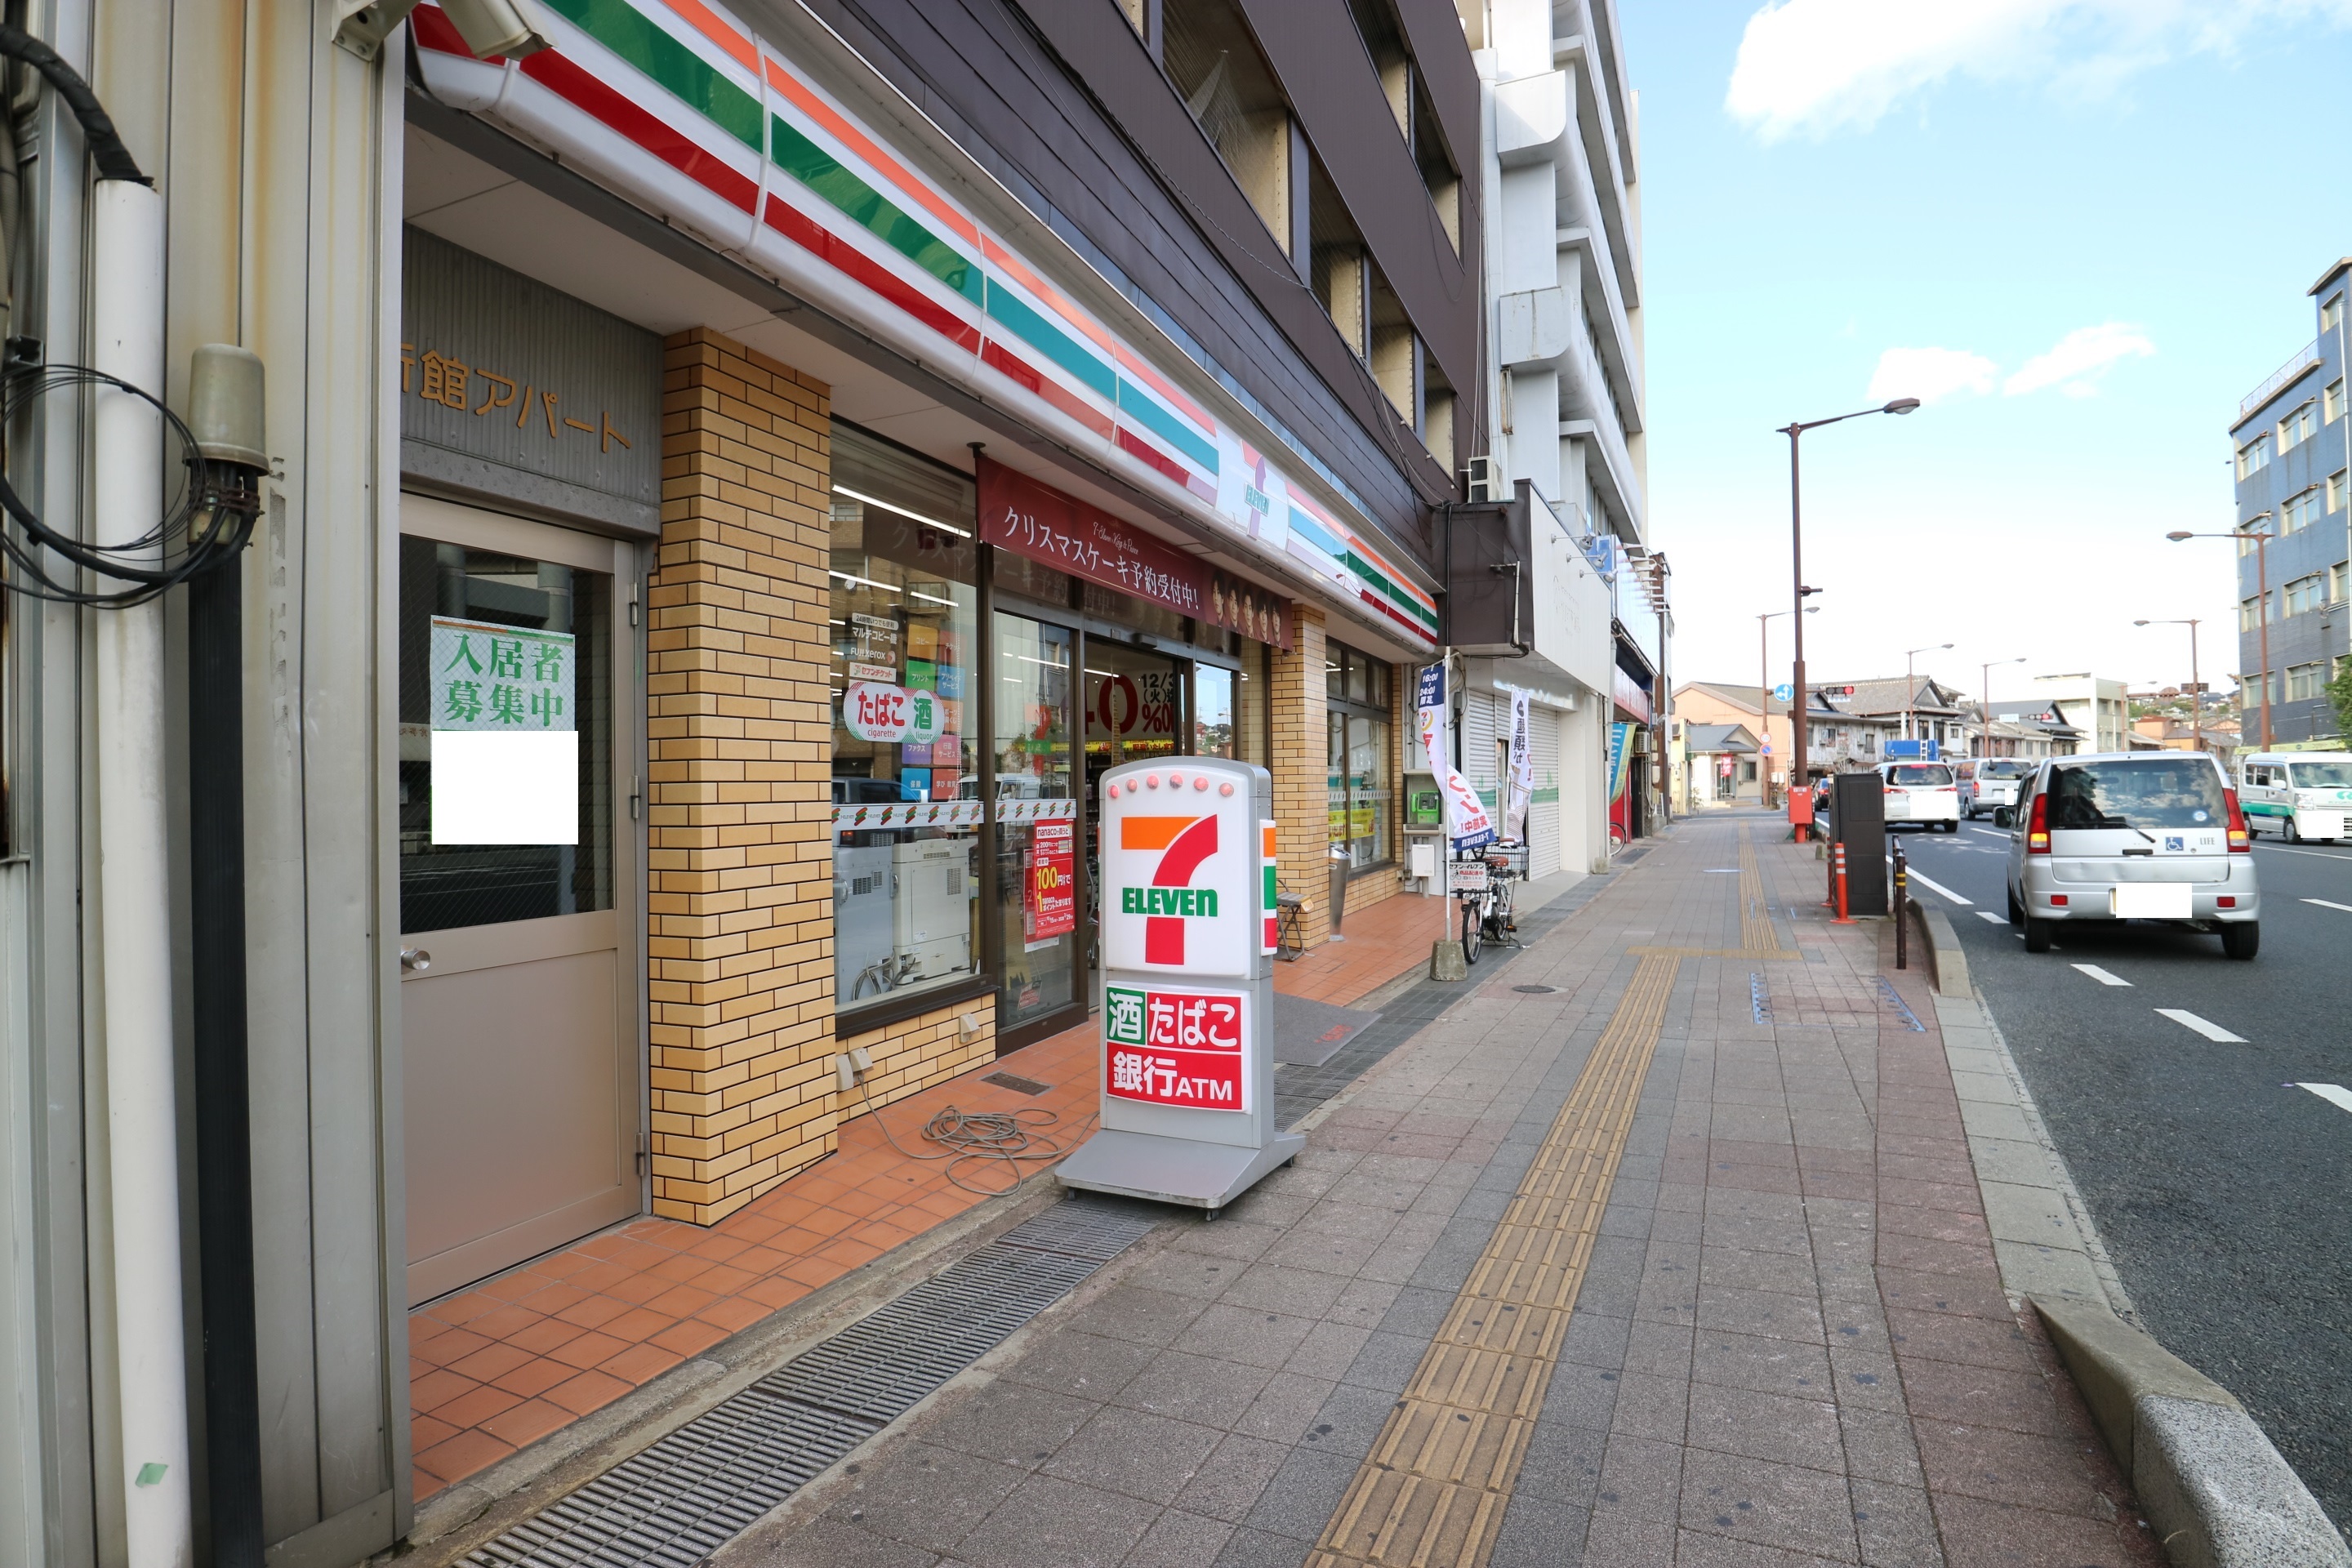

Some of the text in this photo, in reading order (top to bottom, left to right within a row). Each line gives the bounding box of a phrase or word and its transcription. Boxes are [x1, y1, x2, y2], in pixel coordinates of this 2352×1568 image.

[1004, 506, 1199, 610] クリスマスケーキ予約受付中!
[852, 626, 898, 645] マルチコピー機
[915, 637, 930, 645] コピー
[862, 666, 893, 679] セブンチケット
[911, 674, 929, 682] プリント
[1420, 695, 1434, 706] 限定
[858, 690, 905, 727] たばこ
[913, 697, 933, 729] 酒
[867, 728, 897, 739] cigarette
[915, 732, 933, 741] liquor
[911, 780, 921, 788] 保険
[2199, 837, 2216, 845] LIFE
[1109, 991, 1238, 1047] 酒 たばこ
